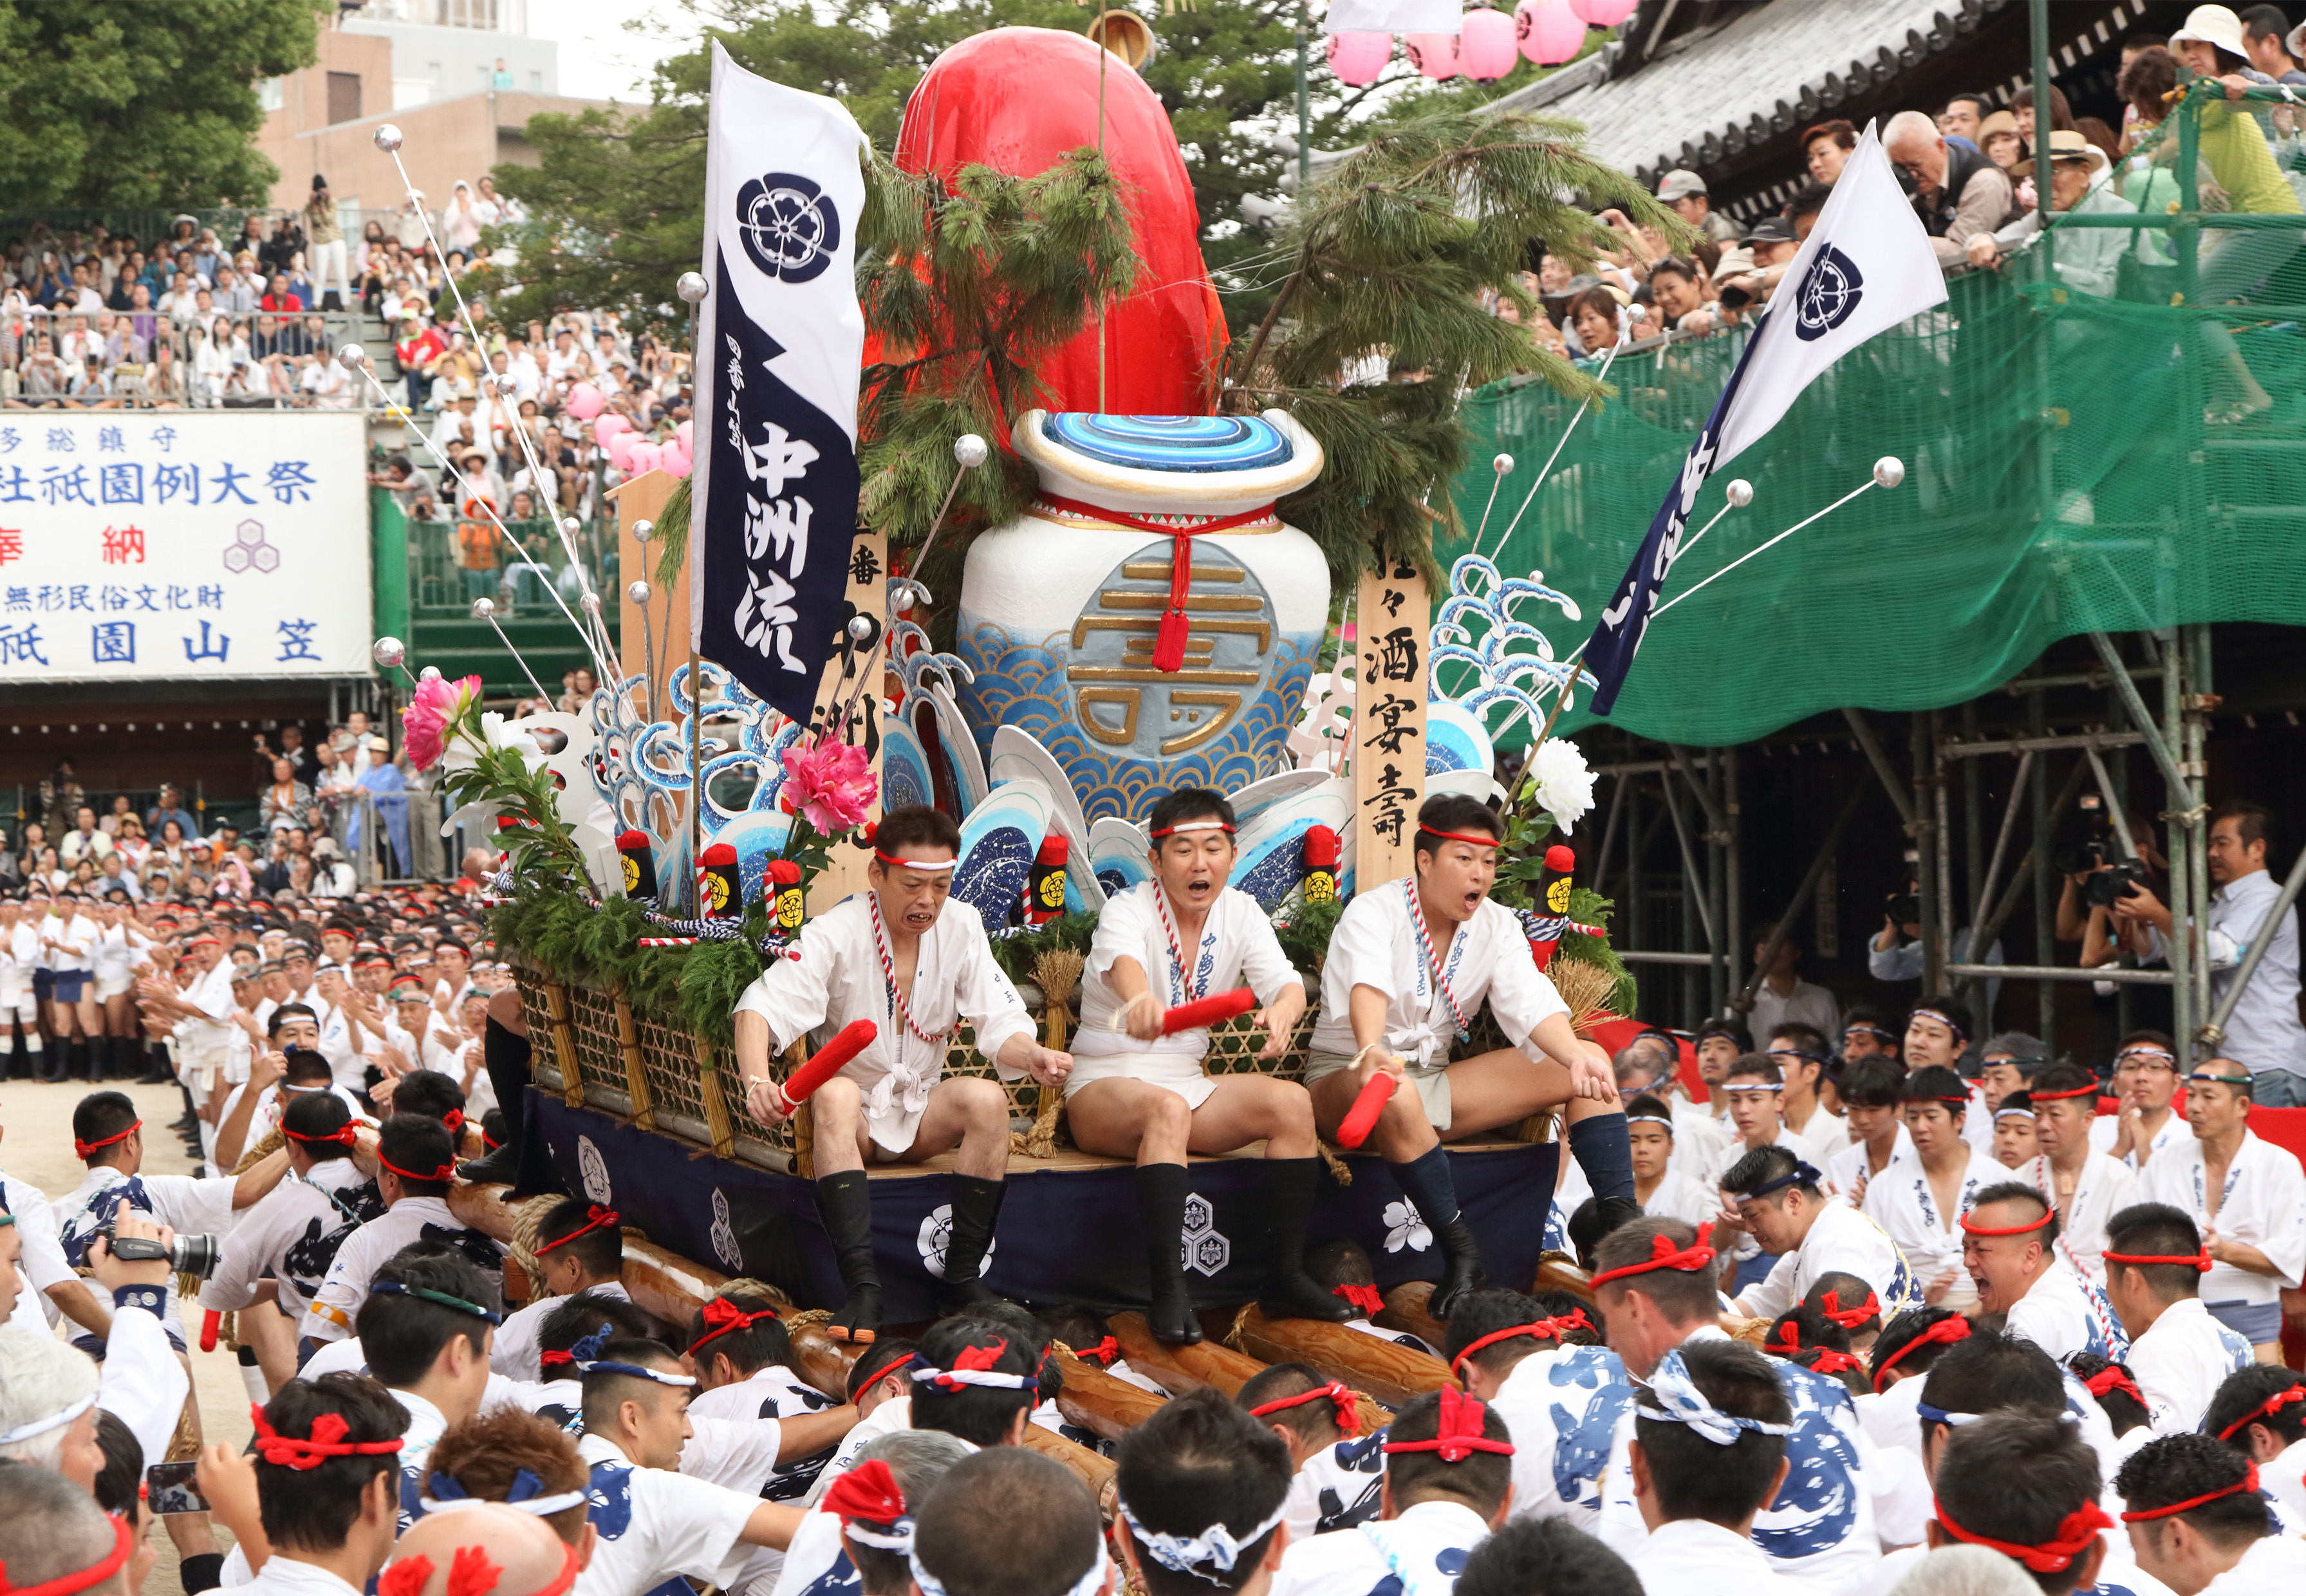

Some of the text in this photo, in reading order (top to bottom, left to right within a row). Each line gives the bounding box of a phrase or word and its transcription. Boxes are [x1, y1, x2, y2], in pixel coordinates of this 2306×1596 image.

[5, 584, 223, 611] 無形民俗文化財
[734, 421, 820, 675] 中洲流
